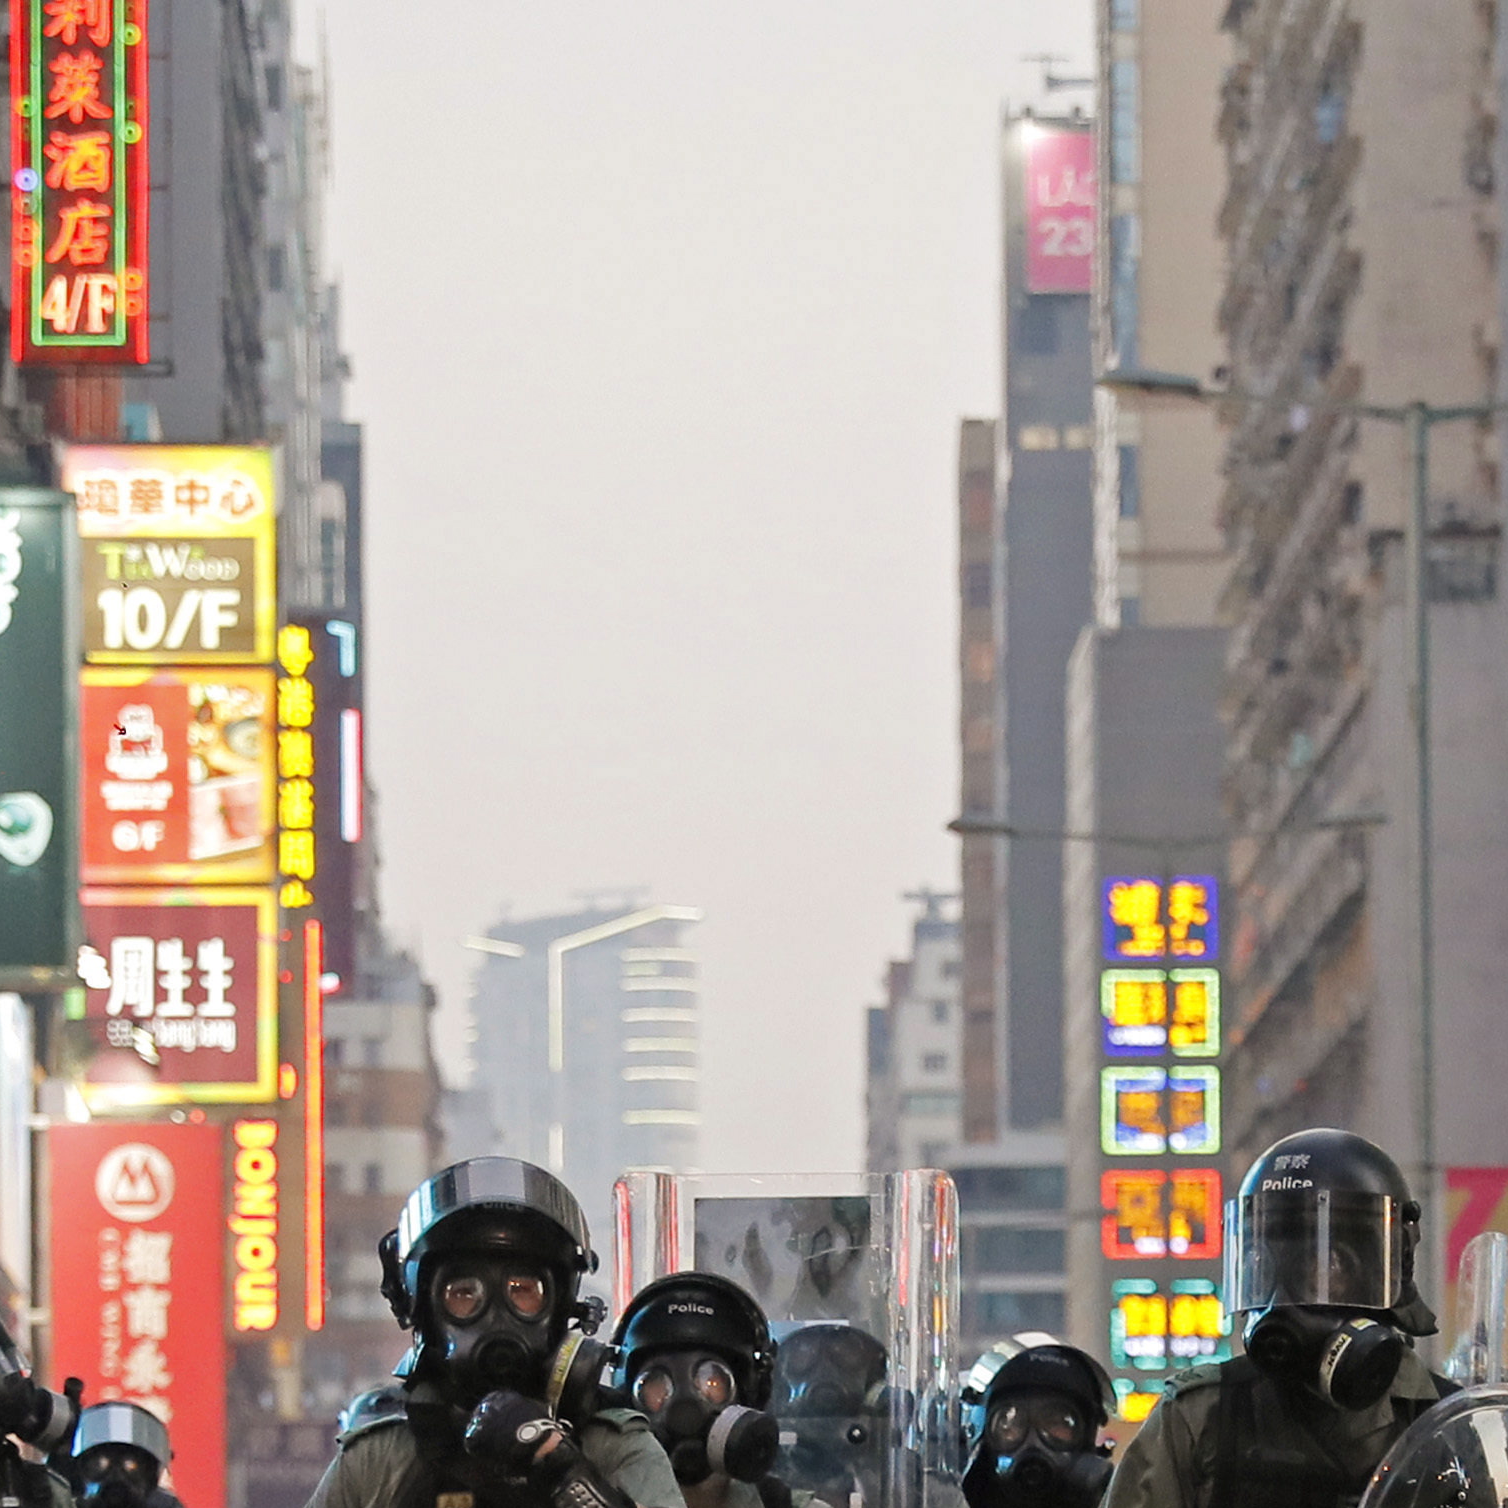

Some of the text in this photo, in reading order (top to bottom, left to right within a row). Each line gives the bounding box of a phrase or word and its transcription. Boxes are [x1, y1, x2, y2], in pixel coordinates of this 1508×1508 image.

[40, 272, 117, 334] 4/F
[97, 588, 242, 650] 10/F
[106, 937, 236, 1018] 周生生
[668, 1303, 714, 1315] Police
